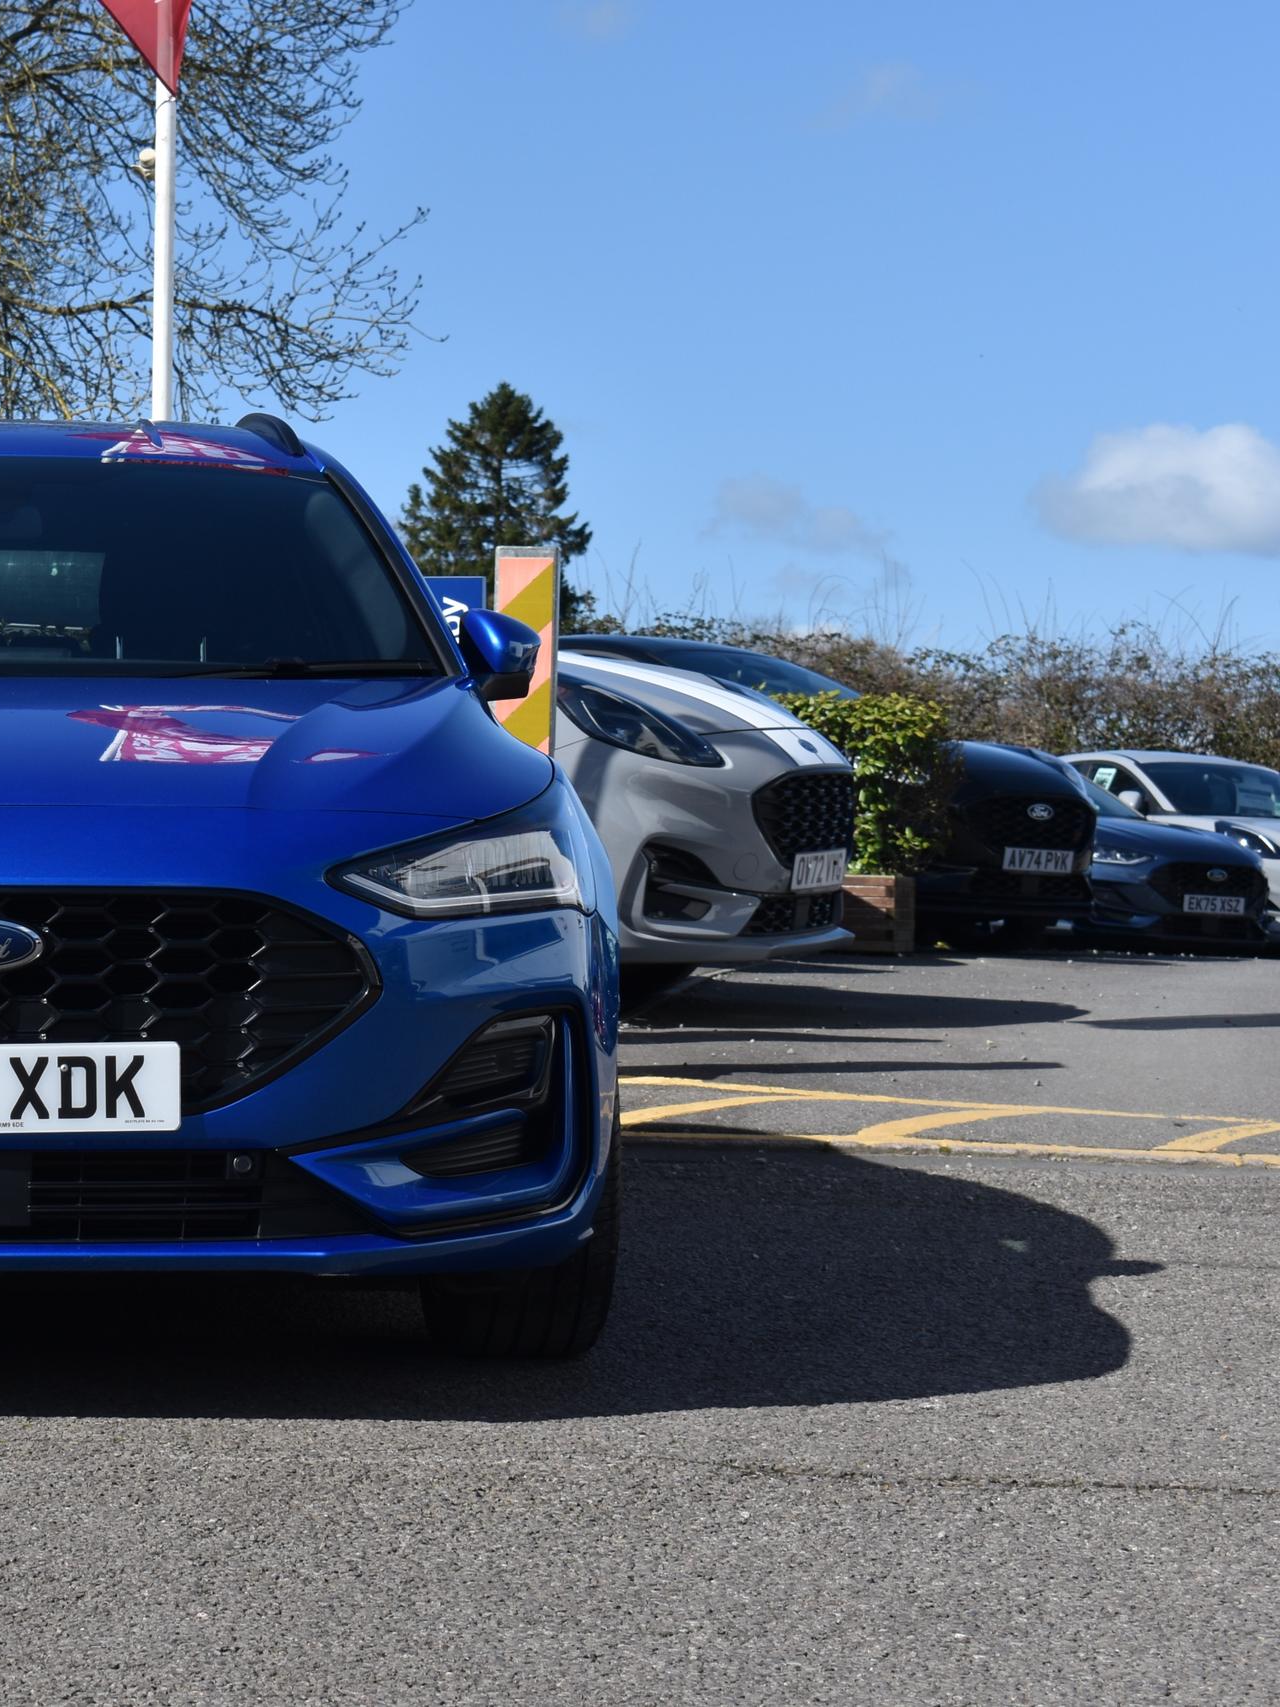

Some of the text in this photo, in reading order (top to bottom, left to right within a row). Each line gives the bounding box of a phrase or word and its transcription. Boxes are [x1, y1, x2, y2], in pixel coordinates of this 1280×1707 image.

[1008, 849, 1042, 869] AV74
[1188, 896, 1218, 912] EK75
[9, 1055, 145, 1120] XDK
